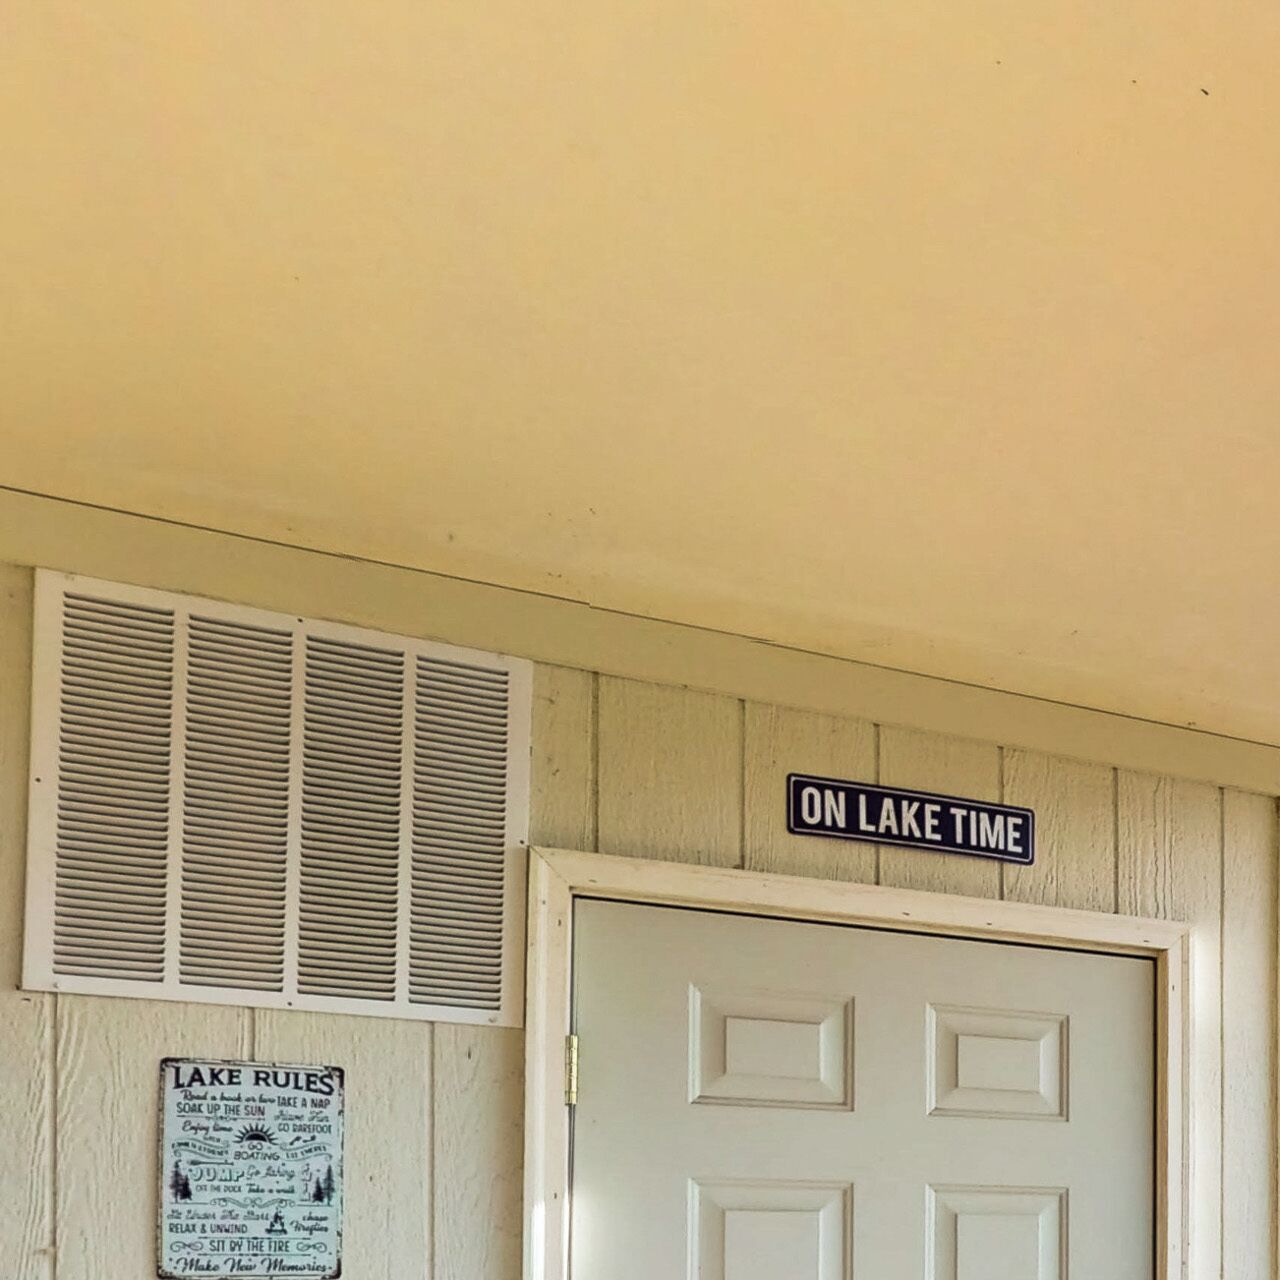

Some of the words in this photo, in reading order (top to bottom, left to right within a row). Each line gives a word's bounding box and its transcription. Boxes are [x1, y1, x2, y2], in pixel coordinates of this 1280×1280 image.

[801, 786, 846, 829] ON
[858, 793, 942, 842] LAKE
[950, 807, 1024, 853] TIME
[173, 1066, 242, 1089] LAKE
[253, 1070, 334, 1096] RULES
[180, 1089, 208, 1101] Read
[177, 1102, 204, 1113] SOAK
[207, 1103, 221, 1114] UP
[224, 1104, 240, 1115] THE
[244, 1105, 265, 1116] SUN
[277, 1096, 297, 1108] TAKE
[301, 1098, 307, 1108] A
[311, 1098, 330, 1109] NAP
[182, 1120, 210, 1135] Enjoy
[278, 1122, 290, 1132] GO
[292, 1123, 332, 1134] BAREFOOT
[248, 1142, 263, 1151] GO
[233, 1151, 280, 1160] BOATING
[188, 1167, 244, 1182] JUMP
[224, 1185, 242, 1193] DOCK
[169, 1223, 197, 1233] RELAX
[200, 1223, 207, 1234] &
[210, 1223, 248, 1234] UNWIND
[209, 1239, 225, 1252] SIT
[230, 1240, 243, 1252] BY
[247, 1240, 264, 1252] THE
[268, 1240, 290, 1252] FIRE
[176, 1257, 220, 1273] Make
[224, 1257, 257, 1273] New
[261, 1257, 327, 1273] Memories
